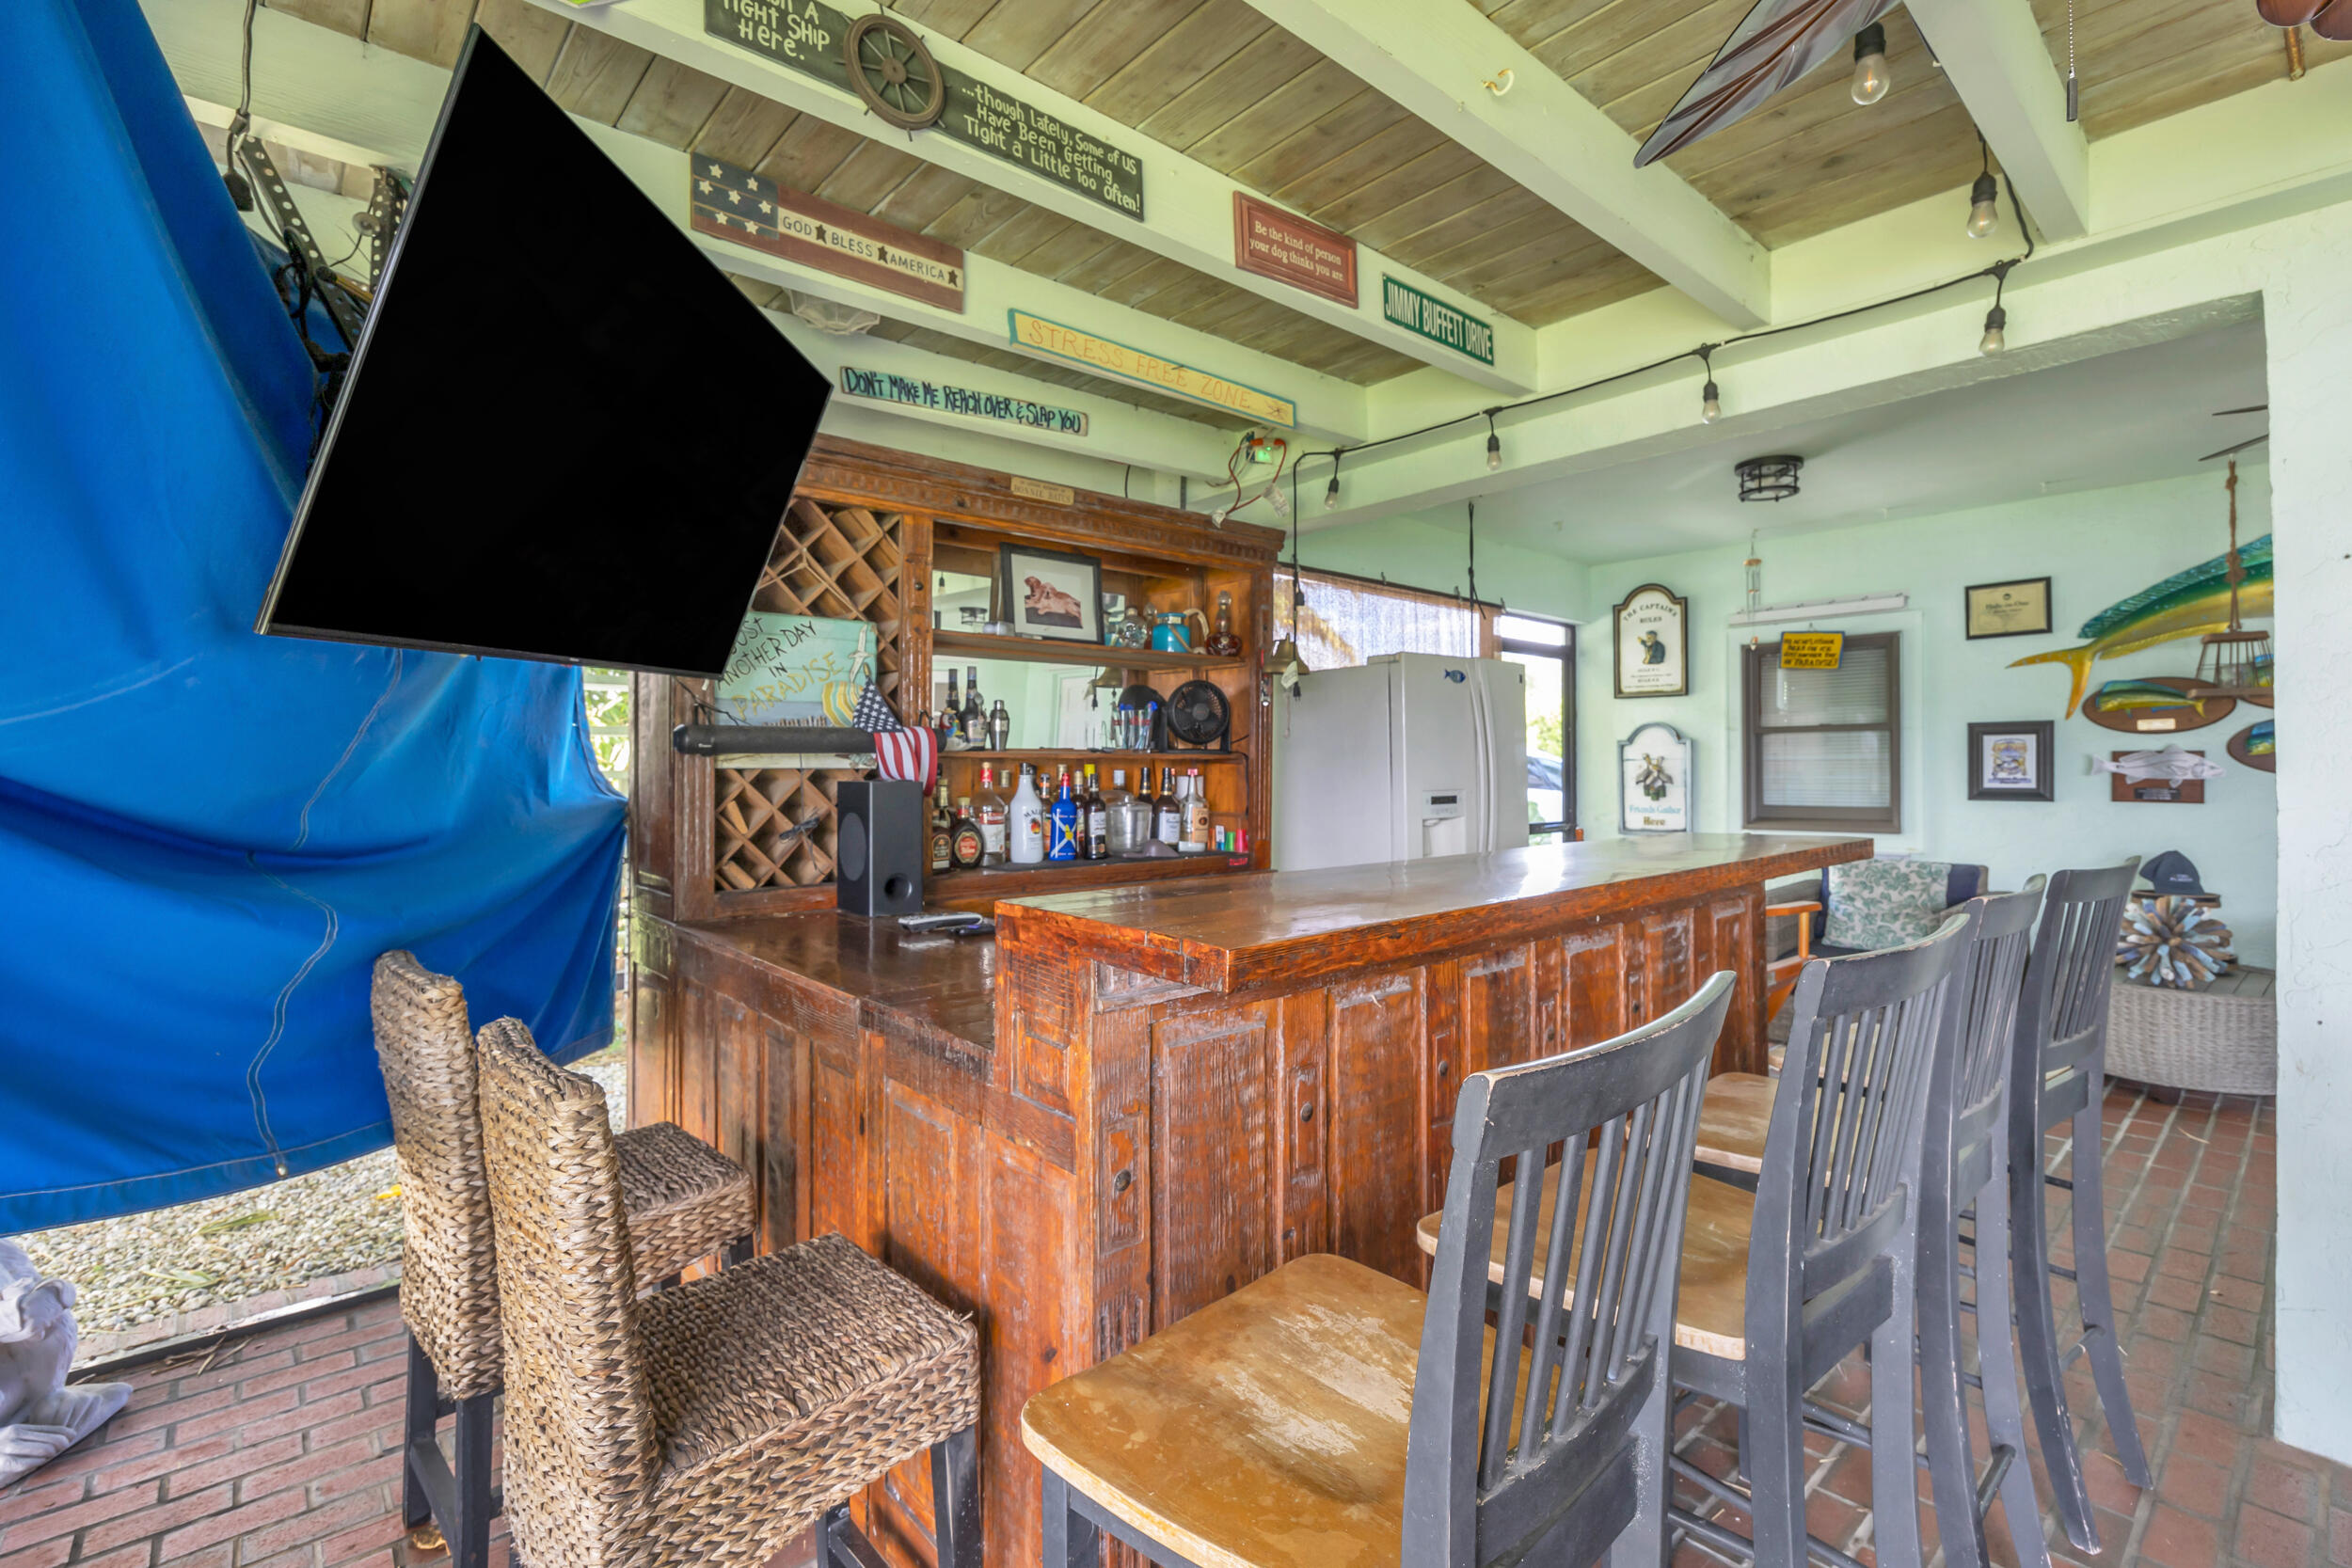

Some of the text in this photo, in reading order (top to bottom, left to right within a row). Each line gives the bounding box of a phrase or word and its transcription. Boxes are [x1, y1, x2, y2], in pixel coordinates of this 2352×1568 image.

[738, 18, 805, 60] Here.
[787, 14, 830, 52] SHIP
[803, 2, 819, 24] A
[963, 114, 1007, 150] Tight
[1012, 139, 1023, 158] a
[1031, 147, 1071, 180] Little
[1075, 167, 1097, 190] Too
[977, 103, 1113, 184] Have Been Getting
[1075, 134, 1104, 158] Some
[1107, 150, 1120, 166] of
[783, 215, 946, 280] GOD BLESS AMERICA
[1249, 238, 1270, 254] your
[1271, 244, 1289, 264] dog
[1290, 250, 1314, 270] thinks
[1315, 262, 1330, 276] you
[1255, 220, 1342, 266] Be the kind of person
[1386, 281, 1493, 361] JIMMY BUFFETT DRIVE
[1029, 320, 1250, 409] STRESS FREE ZONE
[845, 366, 1081, 433] DON'T MAKE ME REACH OVER & SLAP YOU
[1624, 609, 1637, 622] THE
[716, 621, 817, 691] ANOTHER DAY
[768, 661, 788, 678] IN
[731, 651, 843, 721] PARADISE
